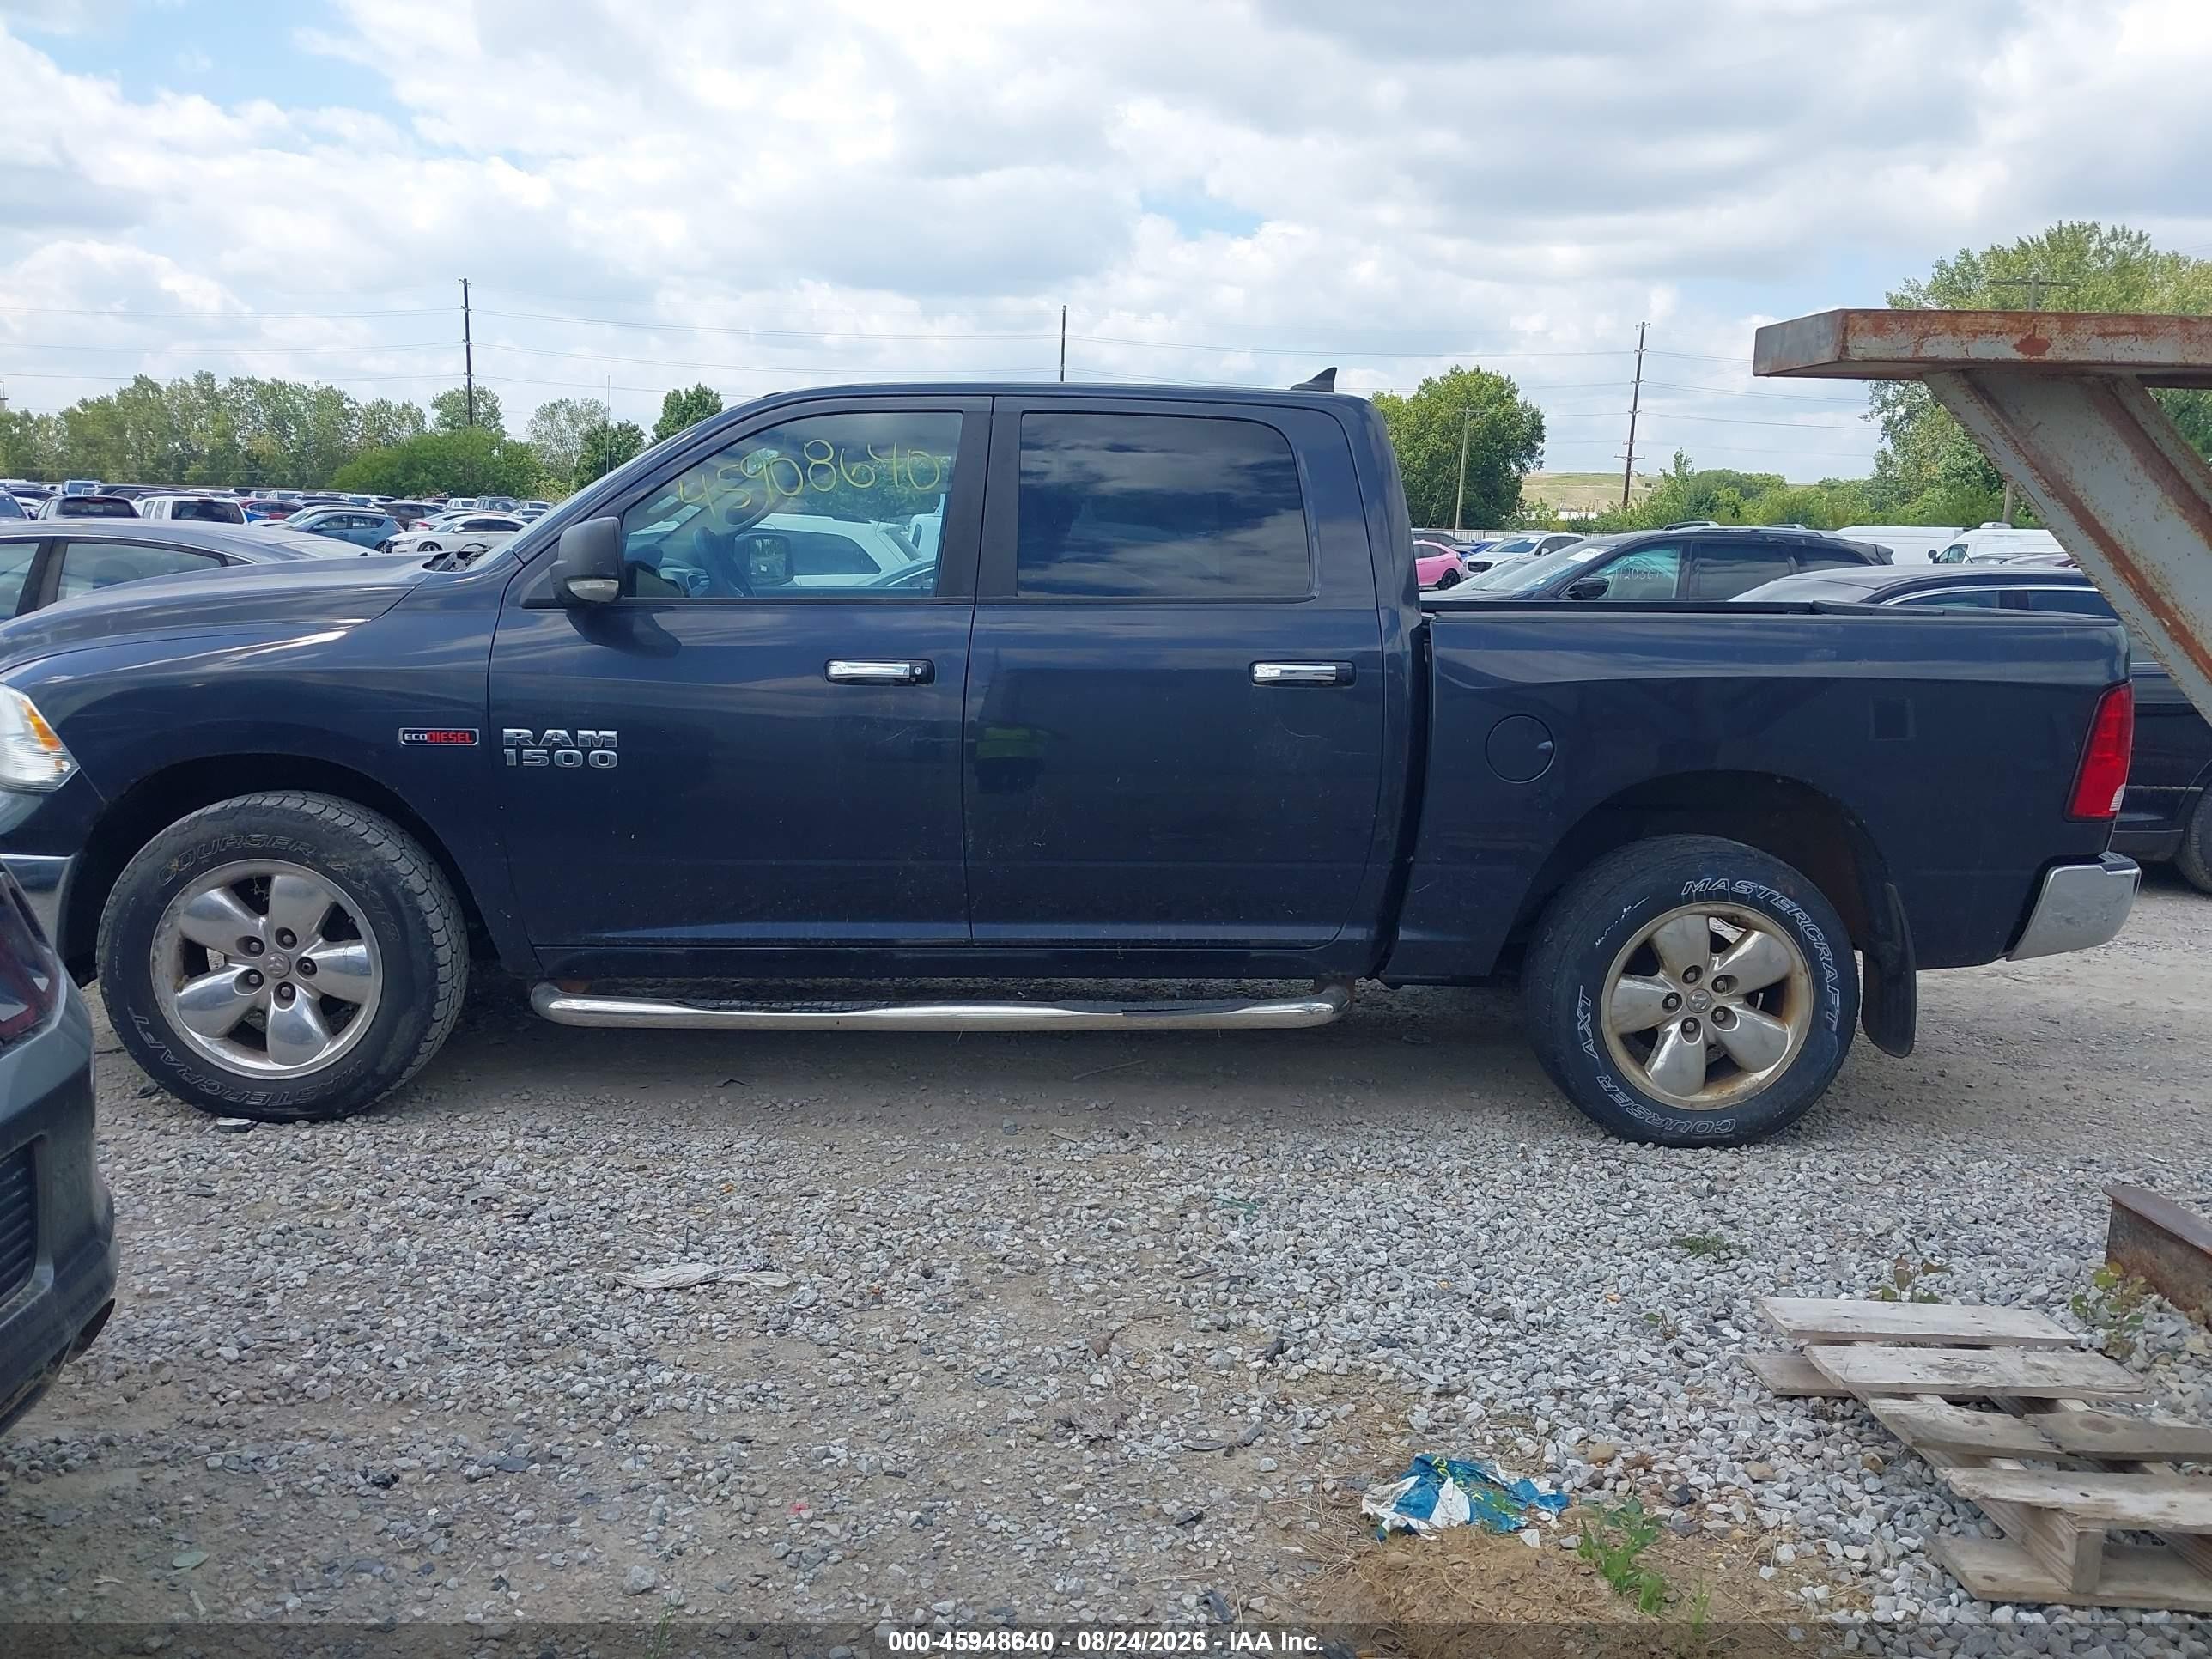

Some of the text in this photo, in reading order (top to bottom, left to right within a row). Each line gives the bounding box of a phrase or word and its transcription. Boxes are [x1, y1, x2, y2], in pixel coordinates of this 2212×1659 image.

[502, 728, 618, 748] RAM
[502, 749, 618, 769] 1500
[157, 833, 318, 886] COURSER
[1680, 877, 1841, 1031] MASTERCRAFT
[128, 1006, 365, 1108] MASTERCRAFT
[1577, 984, 1736, 1134] COURSER AXT
